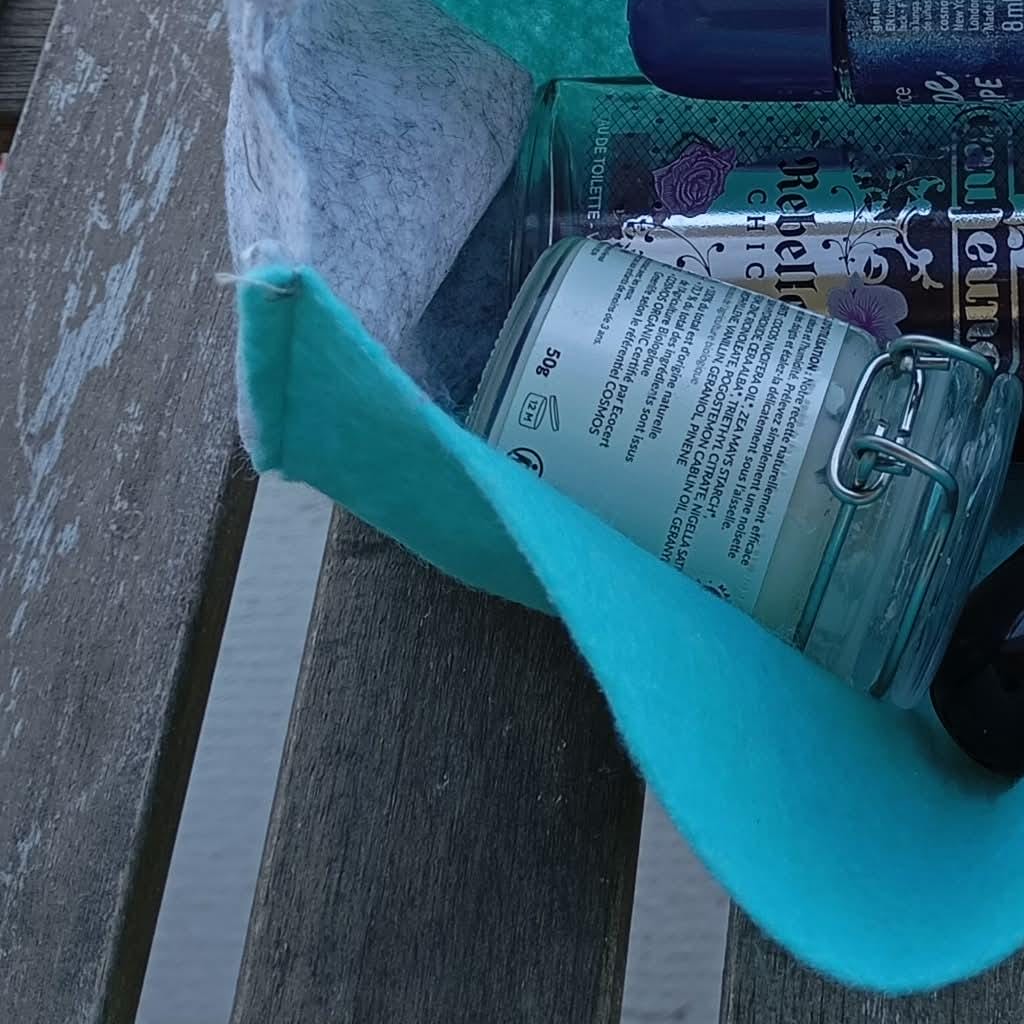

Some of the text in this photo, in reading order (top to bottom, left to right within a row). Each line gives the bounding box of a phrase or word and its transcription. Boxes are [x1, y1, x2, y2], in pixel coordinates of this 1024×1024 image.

[953, 10, 964, 30] New
[983, 4, 995, 30] Made
[1001, 20, 1024, 32] 8
[593, 137, 608, 154] DE
[587, 156, 605, 219] TOILETTE
[745, 188, 766, 279] CHIC
[638, 301, 662, 347] ORGANIC
[666, 330, 682, 349] des
[673, 310, 689, 332] total
[536, 346, 561, 379] 50g
[609, 327, 635, 379] référentiel
[623, 346, 643, 383] certifié
[640, 326, 667, 377] Biologique
[666, 346, 689, 389] d'origine
[751, 340, 773, 384] NUCIFERA
[611, 381, 630, 405] par
[645, 348, 674, 406] ingrédients
[692, 365, 717, 421] GERANIOL,
[589, 379, 616, 435] COSMOS
[635, 407, 650, 433] sont
[648, 391, 672, 439] naturelle
[697, 370, 732, 448] POGOSTEMON
[712, 399, 737, 451] TRIETHYL
[732, 409, 750, 435] ZEA
[747, 386, 778, 454] délicatement
[773, 383, 794, 424] Prélevez
[781, 406, 801, 443] recette
[599, 405, 622, 448] Ecocert
[676, 423, 697, 466] PINENE
[624, 434, 643, 464] issus
[722, 434, 741, 466] MAYS
[737, 456, 753, 482] sous
[748, 426, 780, 492] simplement
[683, 450, 705, 493] CABLIN
[693, 452, 719, 502] CITRATE,
[754, 445, 788, 523] naturellement
[679, 503, 701, 547] NIGELLA
[720, 483, 745, 531] l'aisselle.
[740, 491, 757, 516] une
[726, 516, 749, 560] noisette
[739, 525, 762, 567] efficace
